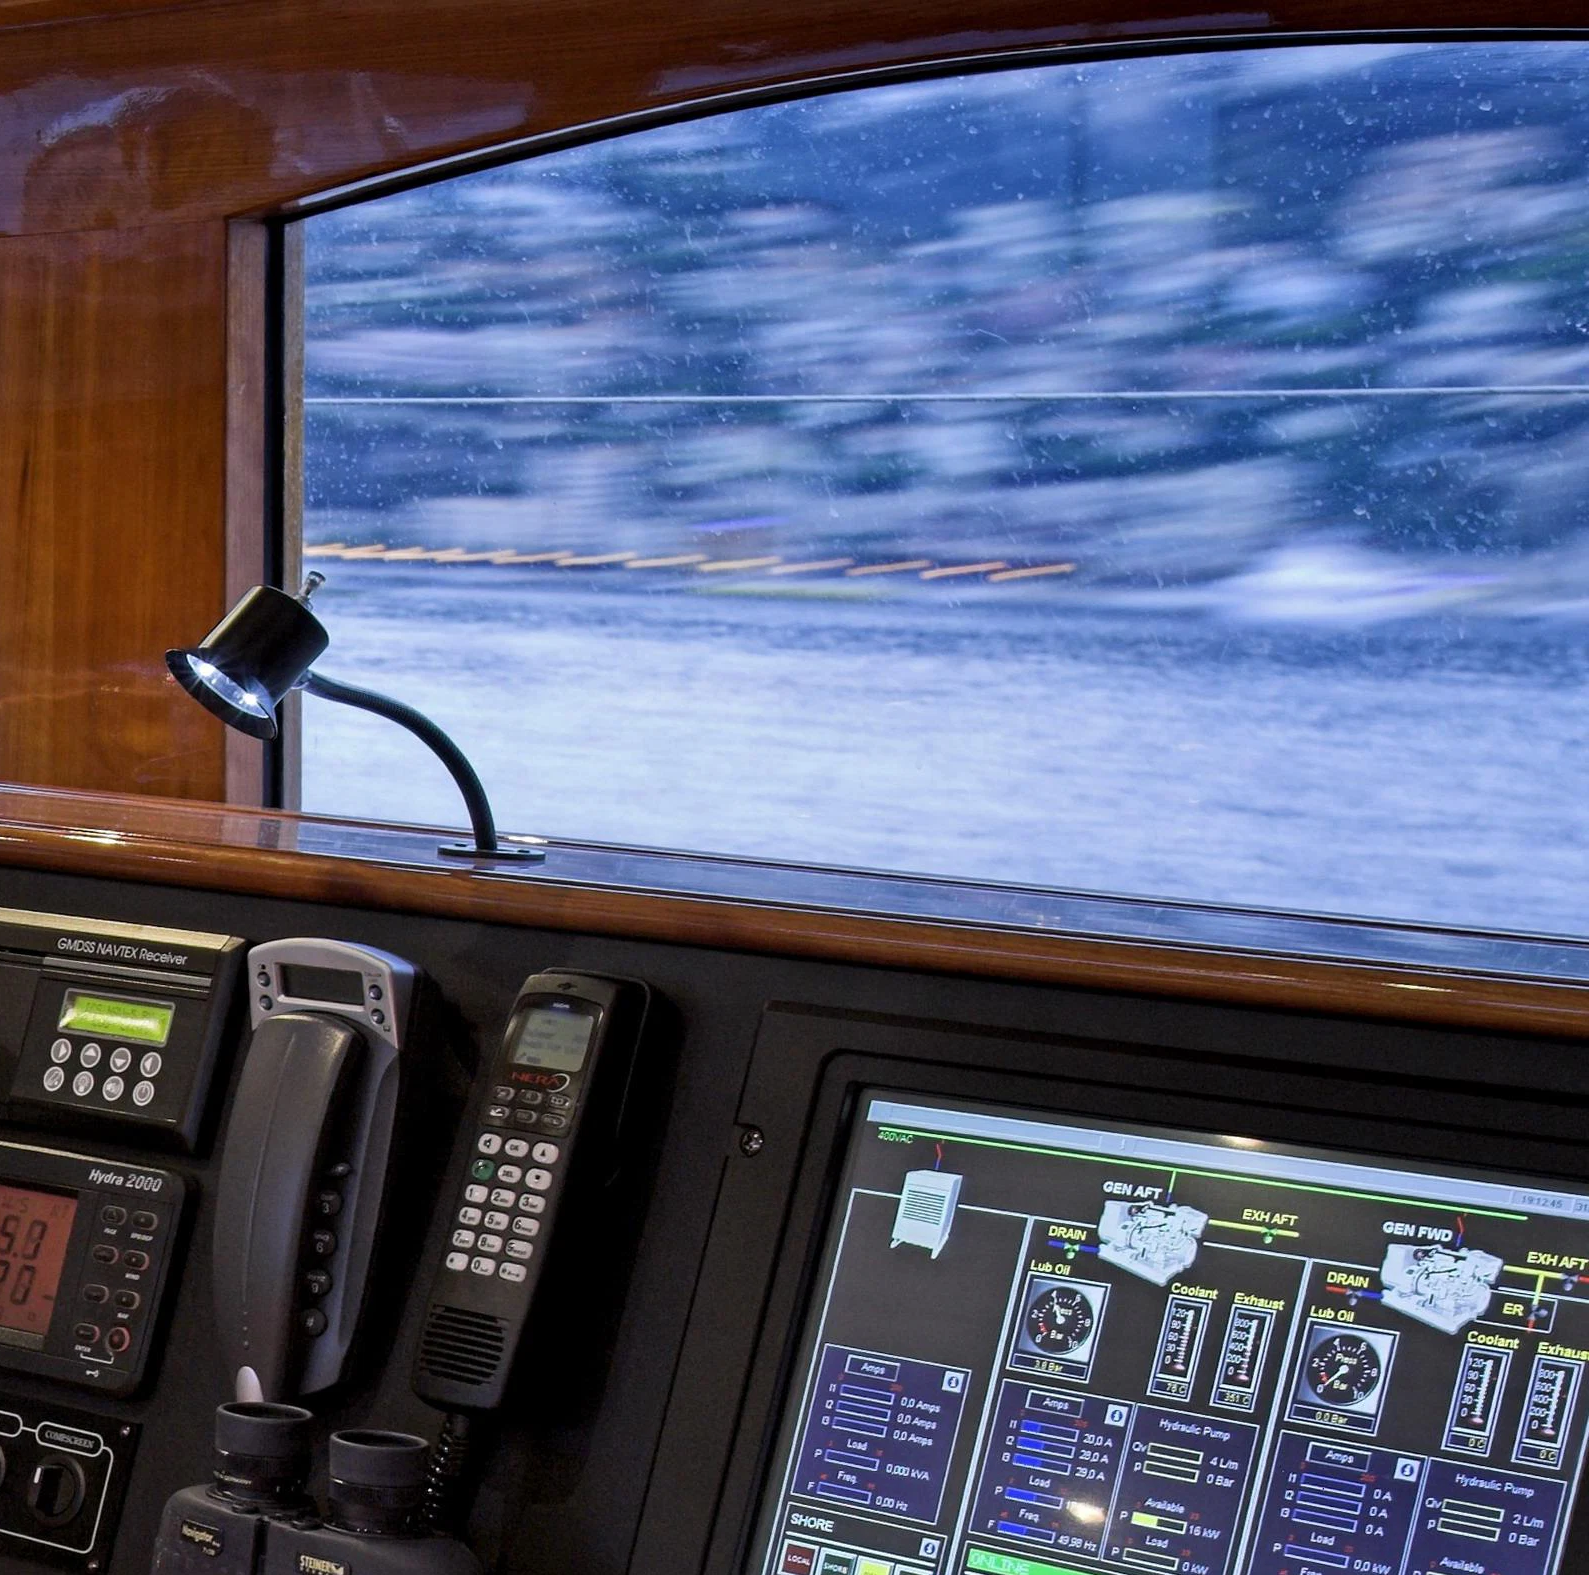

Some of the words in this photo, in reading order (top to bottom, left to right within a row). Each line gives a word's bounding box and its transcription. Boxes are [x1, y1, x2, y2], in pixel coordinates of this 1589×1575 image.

[57, 937, 96, 954] GMDSS
[97, 942, 138, 960] NAVTEX
[140, 948, 188, 966] Receiver
[878, 1130, 914, 1144] 400VAC
[89, 1169, 123, 1188] Hydra
[126, 1173, 162, 1192] 2000
[1103, 1180, 1133, 1196] GEN
[1134, 1185, 1162, 1200] AFT
[1242, 1208, 1268, 1222] EXH
[1269, 1213, 1299, 1226] AFT
[1048, 1225, 1087, 1240] DRAIN
[1383, 1221, 1416, 1237] GEN
[1417, 1227, 1453, 1242] FWD
[1030, 1259, 1053, 1272] Lub
[1055, 1263, 1071, 1275] Oil
[1527, 1251, 1557, 1266] EXH
[1559, 1257, 1588, 1270] AFT
[1327, 1272, 1369, 1288] DRAIN
[1171, 1282, 1218, 1300] Coolant
[1234, 1292, 1285, 1310] Exhaust
[1503, 1302, 1524, 1316] ER
[1310, 1306, 1335, 1320] Lub
[1337, 1310, 1354, 1322] Oil
[1467, 1331, 1519, 1349] Coolant
[860, 1362, 886, 1377] Amps
[916, 1400, 941, 1414] Amps
[1043, 1398, 1068, 1411] Amps
[913, 1417, 937, 1430] Amps
[1159, 1418, 1201, 1437] Hydraulic
[1203, 1426, 1231, 1442] Pump
[847, 1439, 868, 1451] Load
[909, 1433, 933, 1447] Amps
[1325, 1449, 1354, 1465] Amps
[1029, 1475, 1051, 1488] Load
[1215, 1475, 1235, 1489] Bar
[1456, 1472, 1502, 1493] Hydraulic
[1504, 1482, 1534, 1498] Pump
[1144, 1498, 1185, 1514] Available
[790, 1513, 834, 1533] SHORE
[182, 1525, 214, 1543] Navigator
[1202, 1526, 1220, 1540] kW
[1310, 1532, 1335, 1546] Load
[1518, 1533, 1539, 1547] Bar
[787, 1554, 811, 1565] LOCAL
[970, 1550, 1030, 1575] ONLINE
[1440, 1556, 1485, 1575] Available
